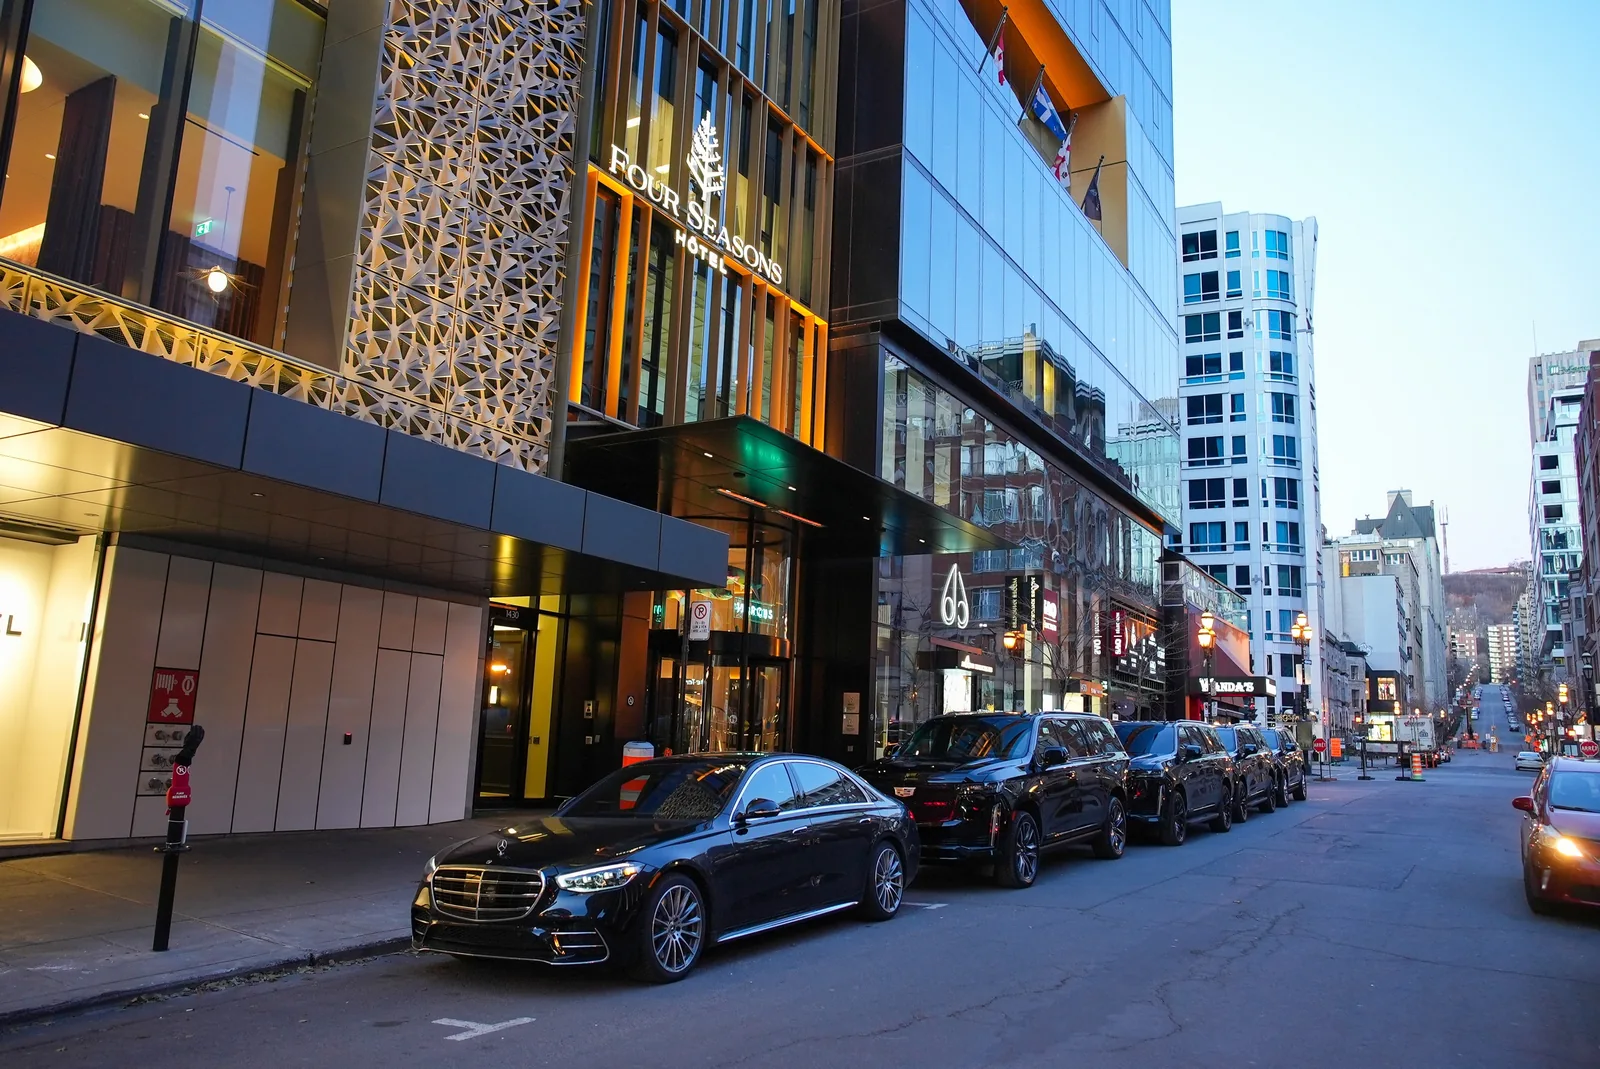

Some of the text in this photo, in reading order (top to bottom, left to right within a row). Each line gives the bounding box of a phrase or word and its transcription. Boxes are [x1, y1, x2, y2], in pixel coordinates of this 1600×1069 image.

[608, 143, 782, 285] FOUR SEASONS
[505, 610, 520, 619] 1430
[734, 602, 773, 620] MRCUS
